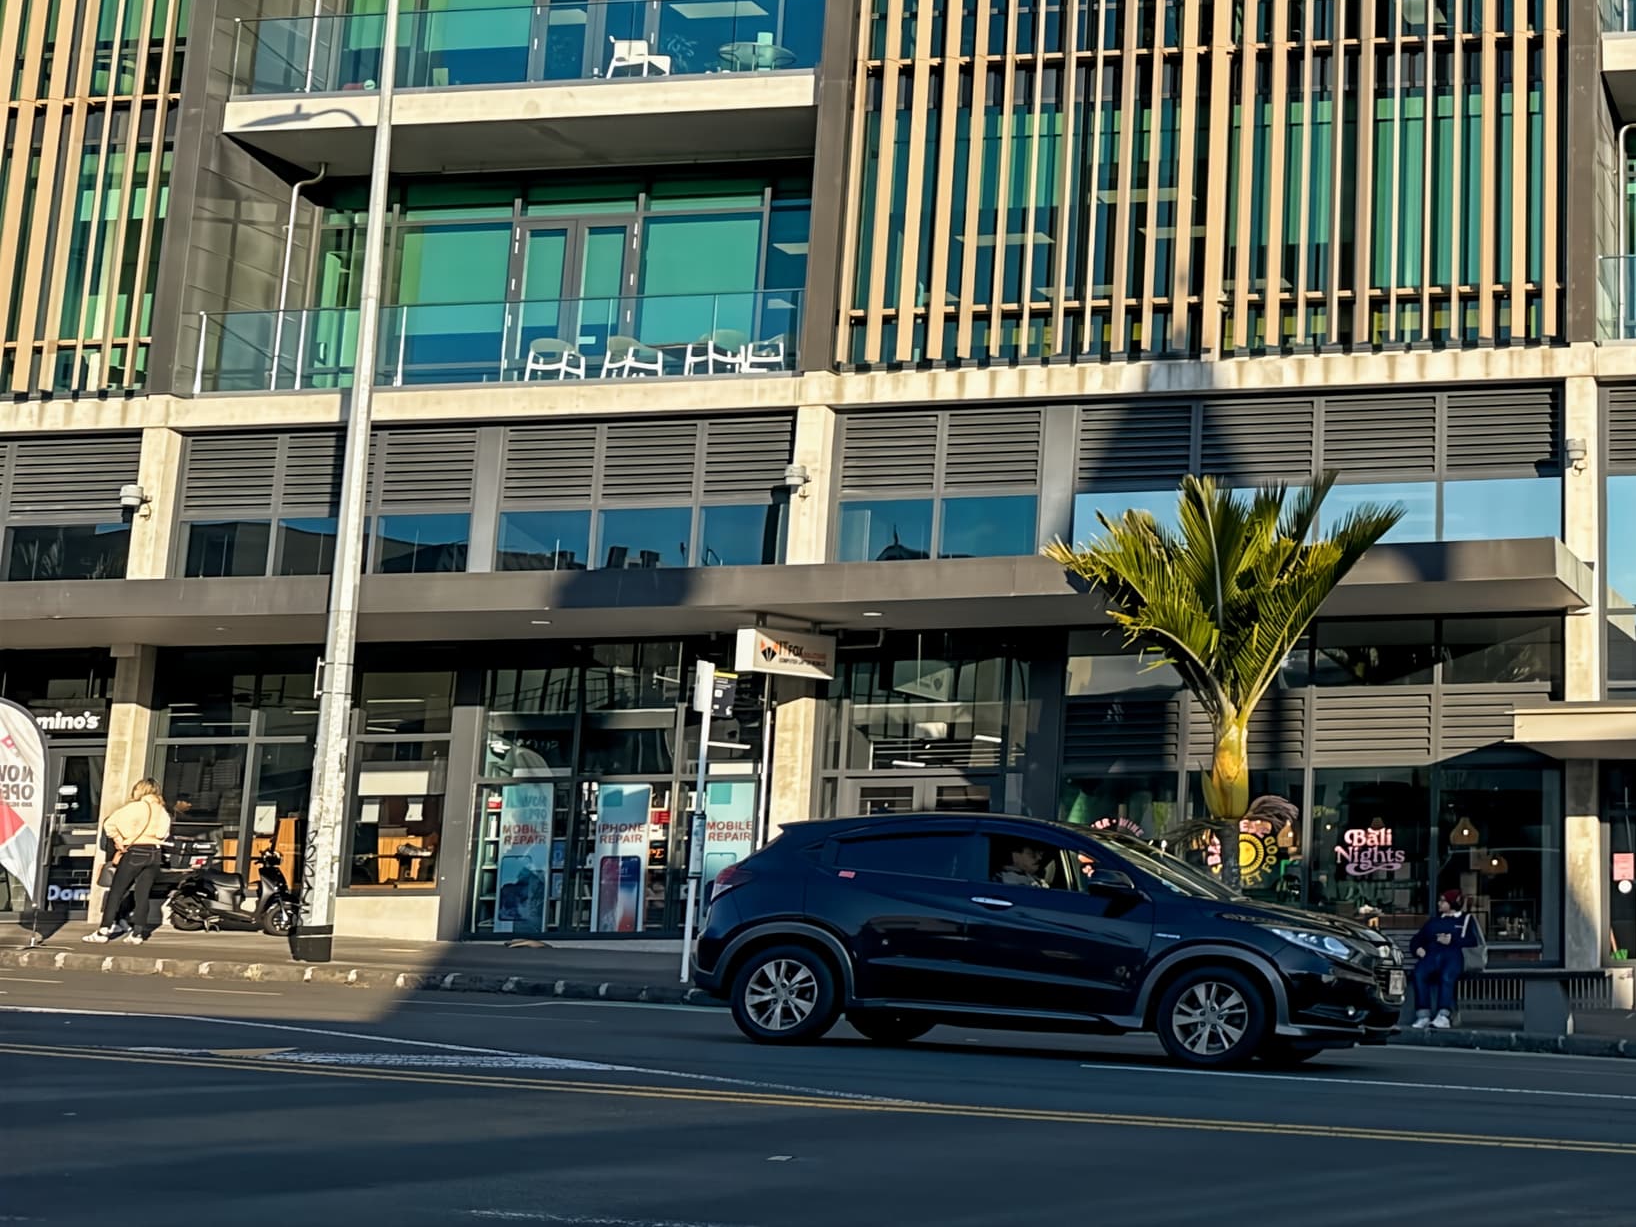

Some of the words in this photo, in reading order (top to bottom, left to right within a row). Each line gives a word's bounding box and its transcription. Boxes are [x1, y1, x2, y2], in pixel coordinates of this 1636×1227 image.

[36, 711, 101, 730] mino's
[502, 822, 549, 834] MOBILE
[598, 823, 645, 833] IPHONE
[706, 821, 753, 831] MOBILE
[504, 835, 546, 845] REPAIR
[600, 834, 643, 844] REPAIR
[708, 831, 752, 842] REPAIR
[1344, 827, 1393, 846] Bali
[1334, 845, 1406, 876] Nights
